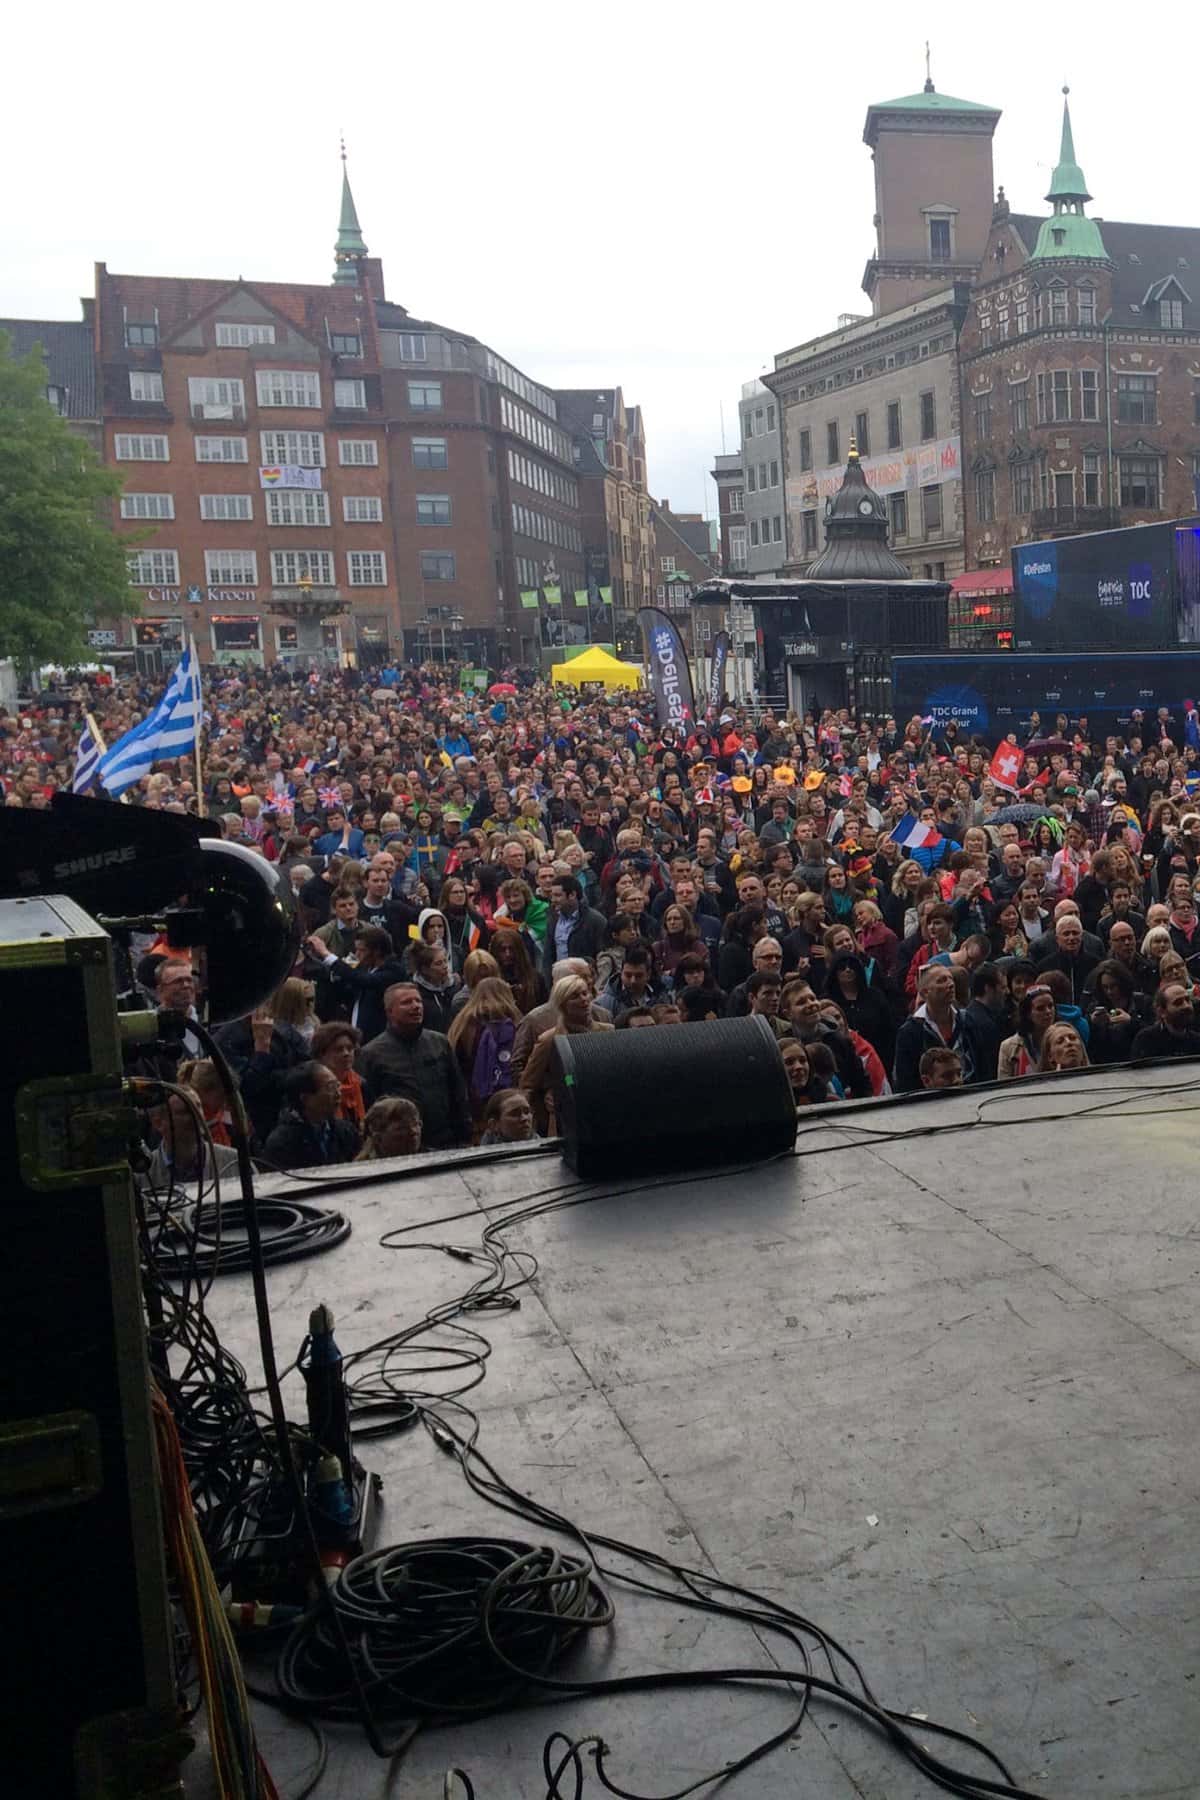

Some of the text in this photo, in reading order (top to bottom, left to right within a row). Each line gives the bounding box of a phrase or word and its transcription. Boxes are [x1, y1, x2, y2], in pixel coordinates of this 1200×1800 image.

[148, 587, 180, 605] City
[1130, 580, 1151, 600] TDC
[931, 706, 978, 716] TDC Grand
[54, 846, 137, 879] SHURE
